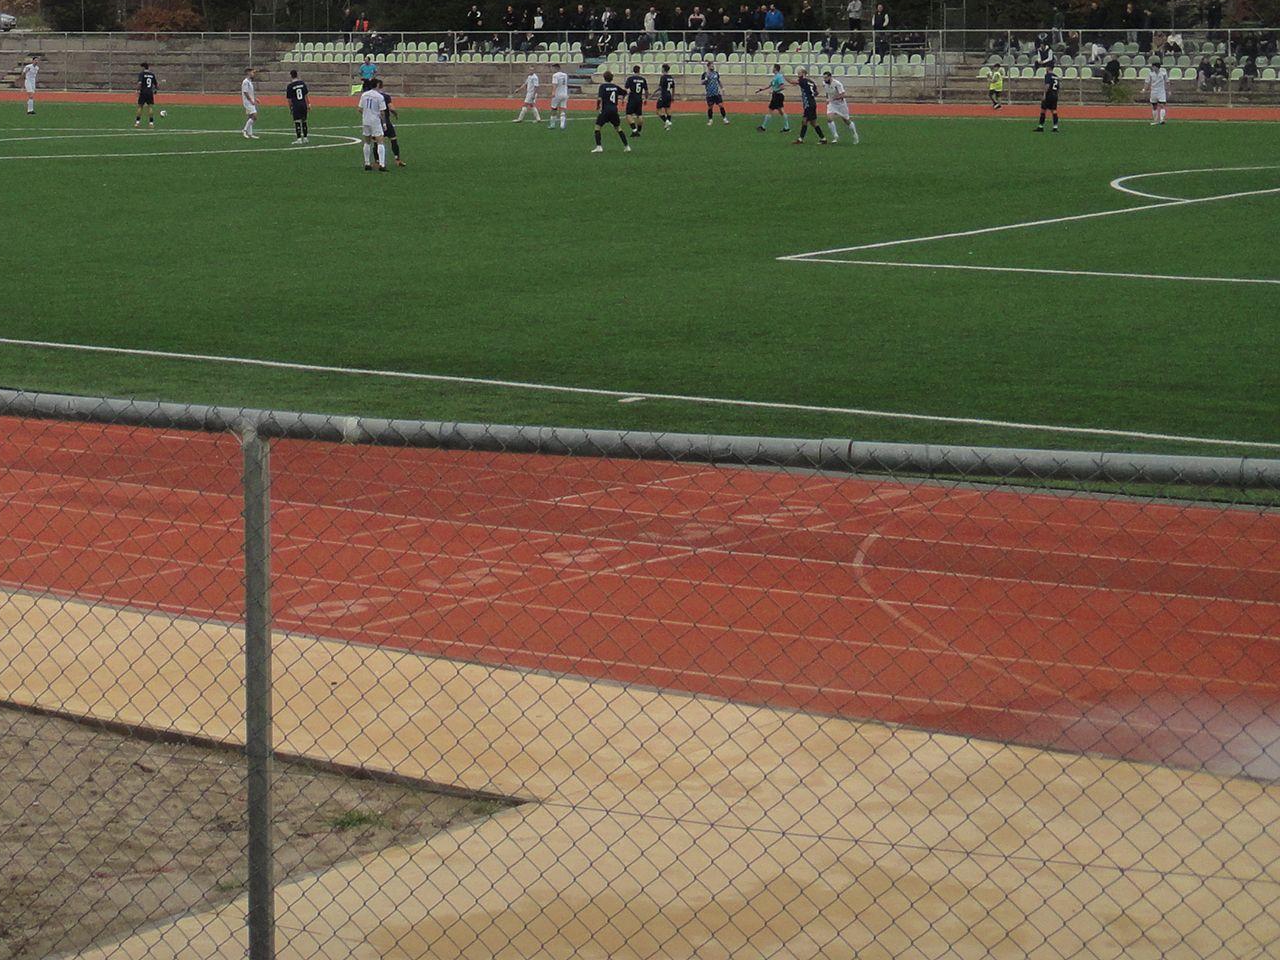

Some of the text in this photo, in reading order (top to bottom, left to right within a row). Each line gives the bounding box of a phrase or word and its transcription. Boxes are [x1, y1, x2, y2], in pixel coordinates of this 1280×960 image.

[146, 78, 152, 88] 9
[1052, 79, 1058, 90] 2
[296, 88, 303, 100] 8
[609, 91, 616, 103] 4
[366, 98, 373, 109] 11
[734, 505, 826, 523] 2
